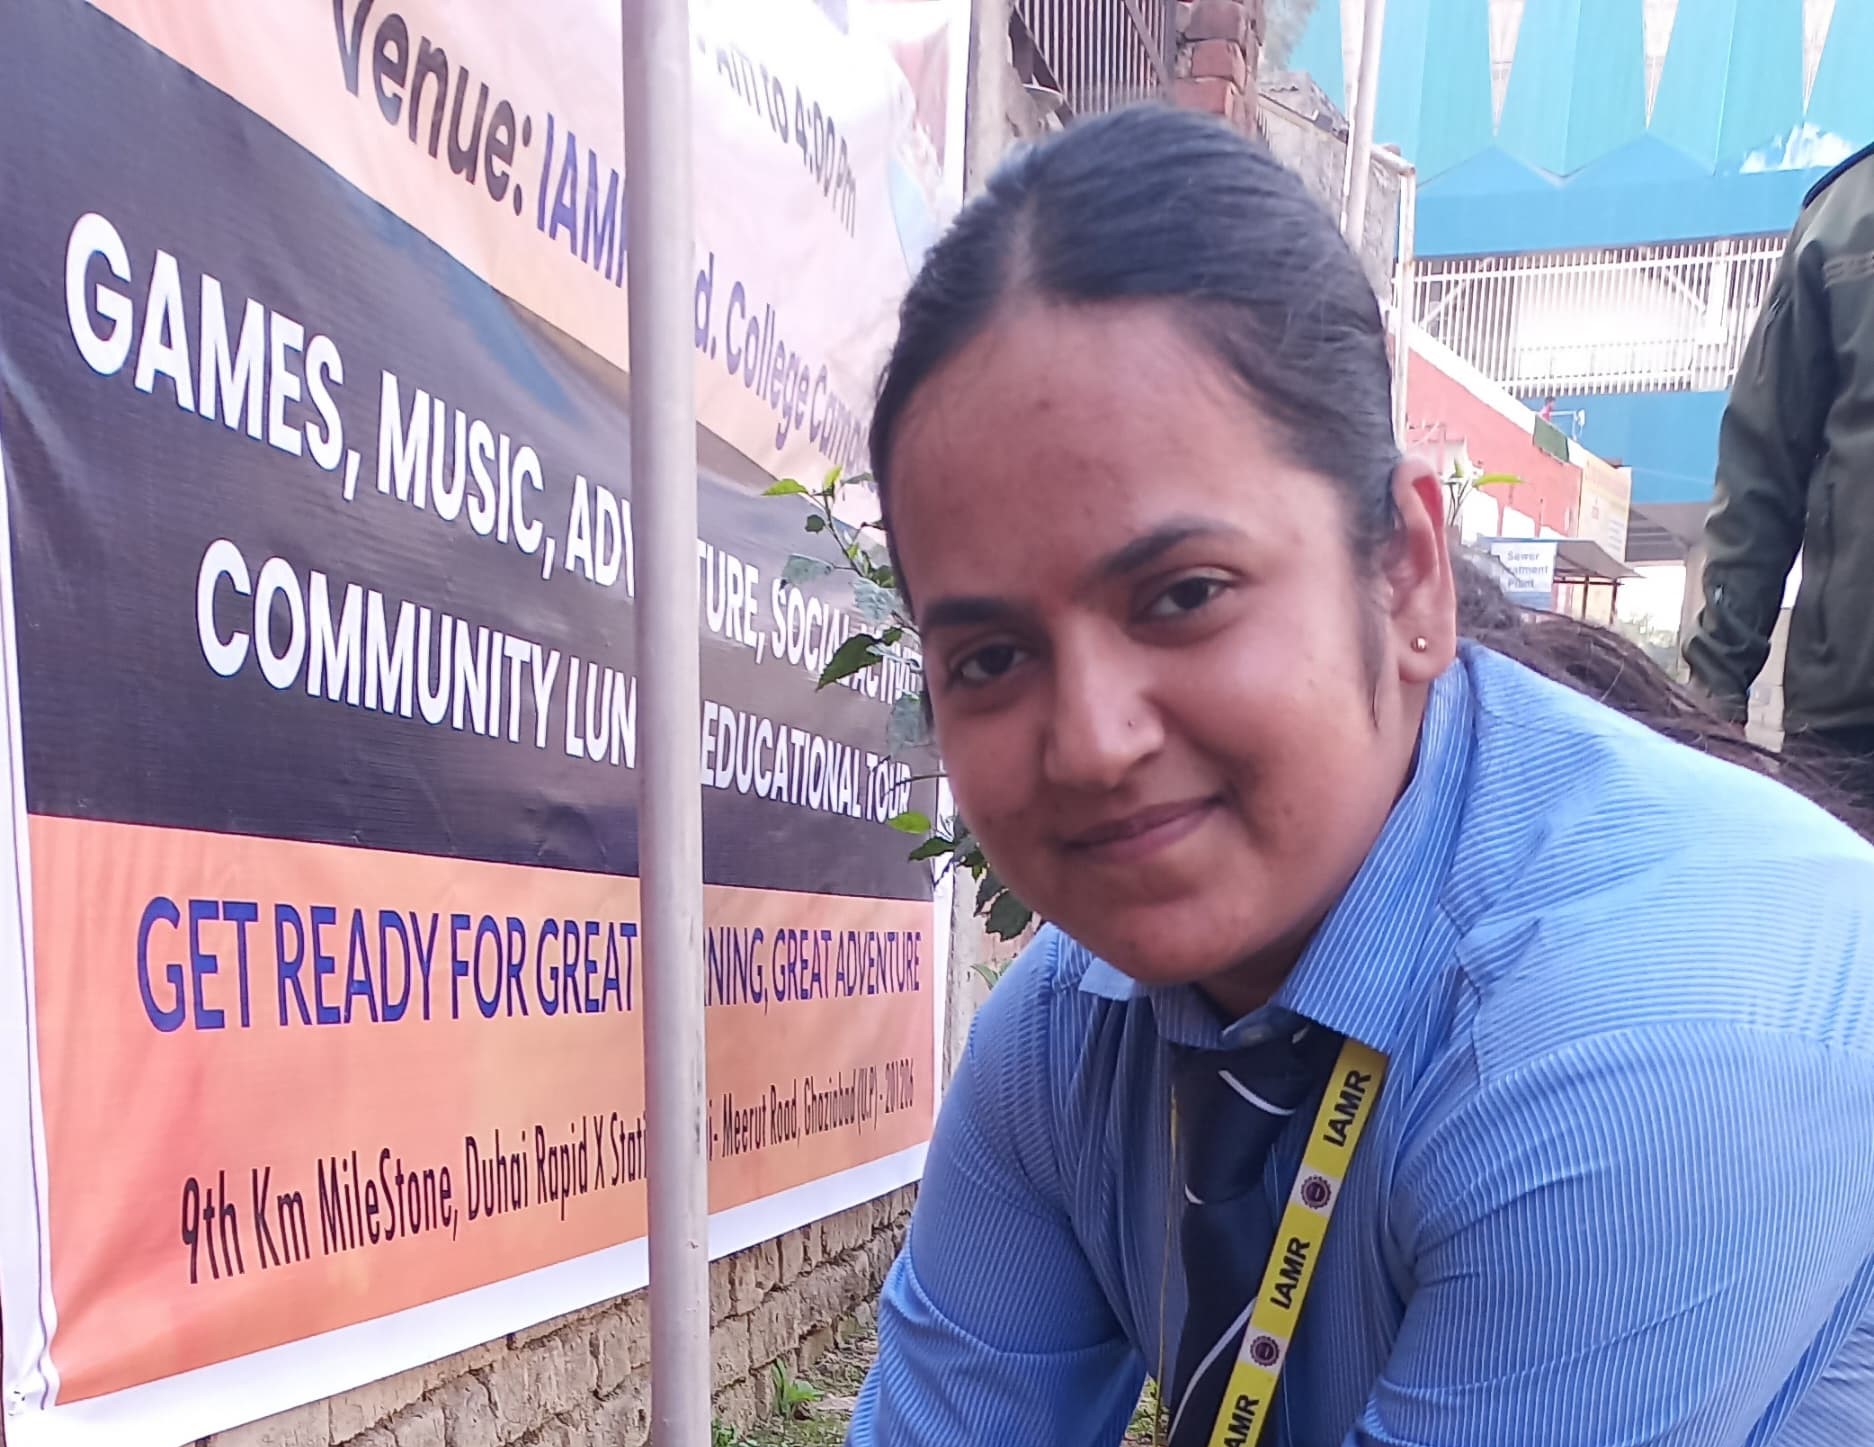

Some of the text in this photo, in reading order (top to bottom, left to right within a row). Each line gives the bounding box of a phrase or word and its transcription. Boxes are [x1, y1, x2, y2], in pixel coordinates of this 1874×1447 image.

[332, 0, 532, 217] Venue:
[537, 112, 628, 289] IAM
[726, 280, 811, 451] College
[65, 211, 361, 501] GAMES,
[376, 369, 556, 581] MUSIC,
[195, 537, 913, 824] COMMUNITY LUN EDUCATIONAL TOUR
[136, 895, 259, 1033] GET
[273, 902, 440, 1028] READY
[450, 913, 530, 1020] FOR
[535, 918, 638, 1017] GREAT
[772, 927, 833, 1003] GREAT
[834, 929, 922, 999] ADVENTURE
[181, 1169, 246, 1285] 9th
[251, 1165, 311, 1270] Km
[317, 1147, 459, 1256] MileStone,
[464, 1128, 529, 1222] Duhai
[534, 1115, 589, 1222] Rapid
[593, 1114, 606, 1191] X
[721, 1092, 767, 1159] Meerut
[769, 1077, 801, 1149] Road,
[803, 1068, 857, 1137] Ghaziabad
[1322, 1069, 1372, 1148] IAMR
[1269, 1236, 1311, 1311] IAMR
